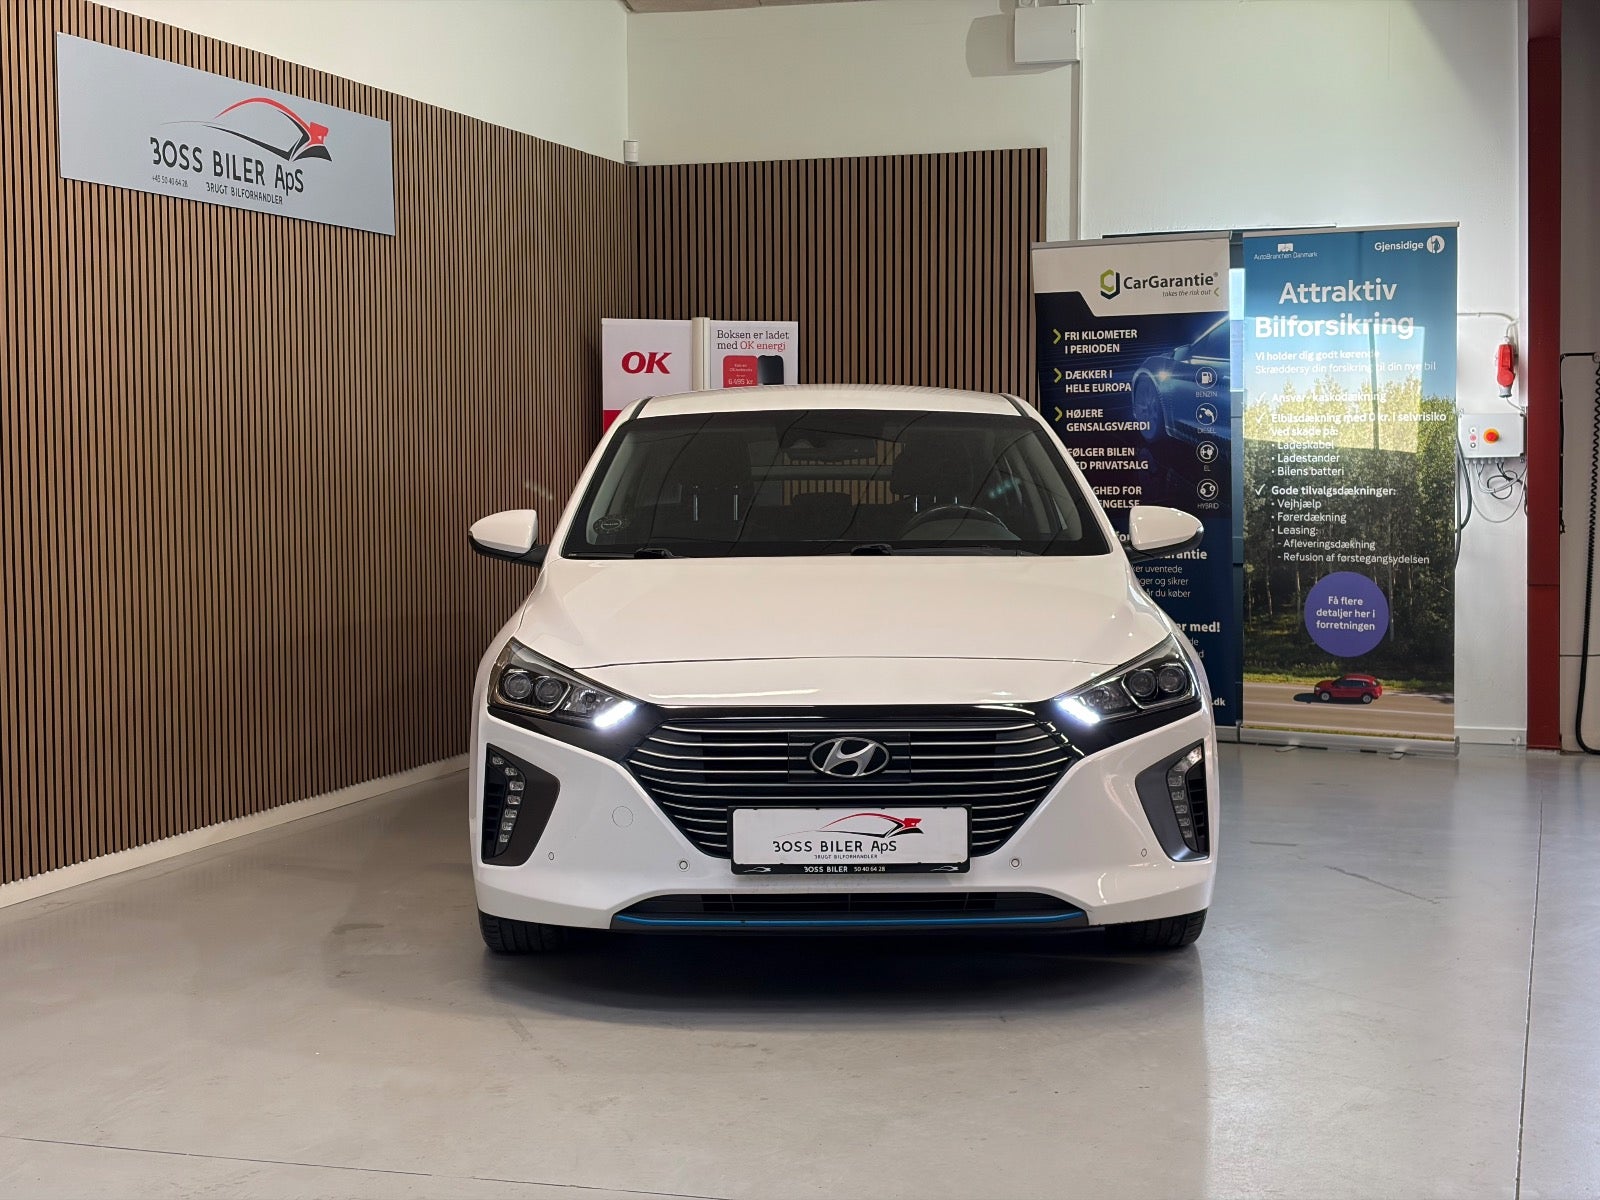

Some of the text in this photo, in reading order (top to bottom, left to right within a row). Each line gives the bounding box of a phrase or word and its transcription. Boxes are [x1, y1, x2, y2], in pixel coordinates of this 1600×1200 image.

[213, 150, 266, 186] BILER
[274, 164, 304, 196] ApS
[230, 186, 283, 205] BILFORHANDLER
[1374, 240, 1425, 253] Gjensidige
[1253, 251, 1319, 261] AutoBranchen Danmark
[1123, 272, 1214, 290] CarGarantie
[1278, 277, 1398, 305] Attraktiv
[1254, 311, 1415, 340] Bilforsikring
[716, 329, 790, 341] Boksen er ladet
[1064, 329, 1138, 341] FRI KILOMETER
[717, 340, 787, 353] med OK energi
[1064, 343, 1120, 355] I PERIODEN
[1255, 352, 1265, 361] Vi
[1266, 351, 1298, 361] holder
[1298, 351, 1315, 362] dig
[1315, 350, 1339, 361] godt
[621, 351, 672, 375] OK
[1255, 364, 1309, 376] Skræddersy
[1311, 364, 1327, 373] din
[1387, 362, 1402, 371] din
[1404, 362, 1422, 373] nye
[1424, 361, 1437, 371] bil
[1065, 370, 1114, 380] DÆKKER I
[1065, 383, 1132, 393] HELE EUROPA
[1312, 391, 1387, 403] kaskodækning
[1066, 409, 1103, 419] HØJERE
[1271, 414, 1341, 425] Elbilsdækning
[1343, 413, 1367, 423] med
[1368, 413, 1376, 422] 0
[1397, 412, 1447, 422] selvrisiko
[1066, 422, 1150, 431] GENSALGSVÆRDI
[1271, 427, 1339, 438] ved skade på:
[1277, 440, 1335, 449] Ladeskabel
[1106, 447, 1135, 456] BILEN
[1277, 453, 1340, 463] Ladestander
[1089, 460, 1149, 470] PRIVATSALG
[1277, 467, 1345, 476] Bilens batteri
[1092, 486, 1142, 495] GHED FOR
[1271, 485, 1397, 497] Gode tilvalgsdækninger:
[1277, 499, 1322, 511] Vejhjælp
[1277, 512, 1347, 524] Førerdækning
[1277, 525, 1319, 537] Leasing:
[1283, 538, 1376, 550] Afleveringsdækning
[1283, 553, 1430, 568] Refusion af førstegangsydelsen
[1145, 565, 1183, 573] uventede
[1155, 579, 1166, 587] og
[1167, 577, 1189, 586] sikrer
[1155, 589, 1166, 597] du
[1168, 589, 1191, 597] køber
[1328, 596, 1364, 606] Få flere
[1316, 608, 1352, 620] detaljer
[1354, 608, 1371, 618] her
[1189, 622, 1221, 633] med!
[1316, 621, 1376, 632] forretningen
[820, 840, 863, 853] BILER
[871, 840, 897, 854] ApS
